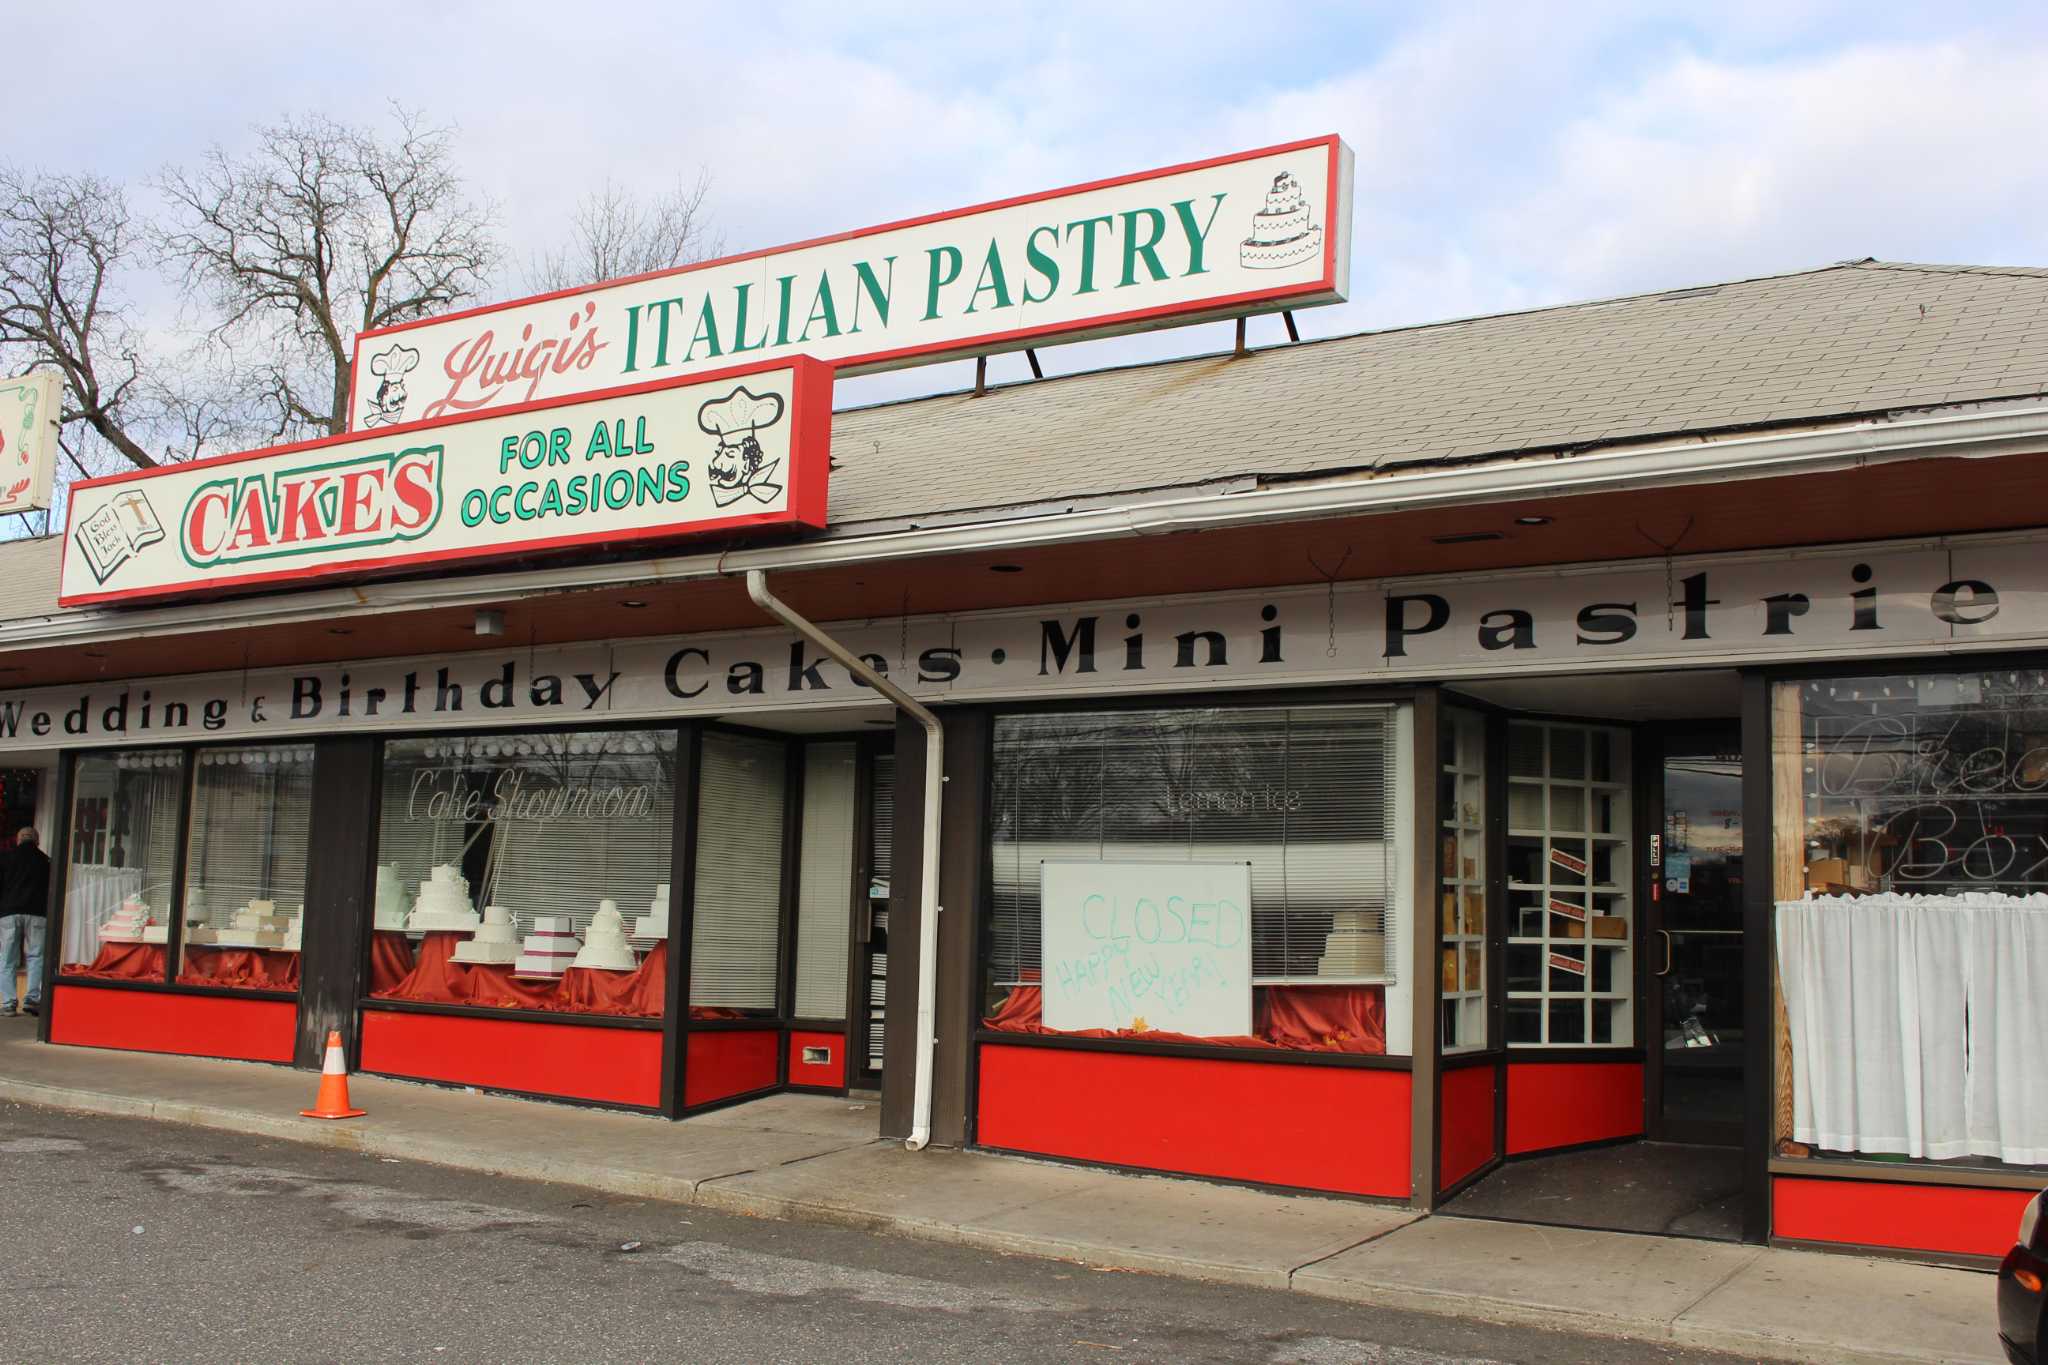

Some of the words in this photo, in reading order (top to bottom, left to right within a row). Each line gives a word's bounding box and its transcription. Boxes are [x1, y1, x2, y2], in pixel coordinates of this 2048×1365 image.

[422, 300, 609, 419] Luigi's
[620, 256, 898, 373] ITALIAN
[919, 193, 1228, 321] PASTRY
[500, 425, 573, 475] FOR
[586, 415, 654, 462] ALL
[90, 511, 111, 533] God
[189, 460, 439, 556] CAKES
[461, 461, 691, 529] OCCASIONS
[0, 690, 228, 738] Wedding
[251, 696, 268, 723] &
[289, 661, 622, 719] Birthday
[664, 640, 962, 699] Cakes
[1037, 605, 1285, 677] Mini
[1382, 562, 2000, 659] Pastrie
[408, 769, 481, 820] Cake
[489, 768, 649, 820] Showroom
[1082, 894, 1244, 949] CLOSED
[1056, 941, 1131, 999] HAPPY
[1108, 957, 1160, 1021] NEW
